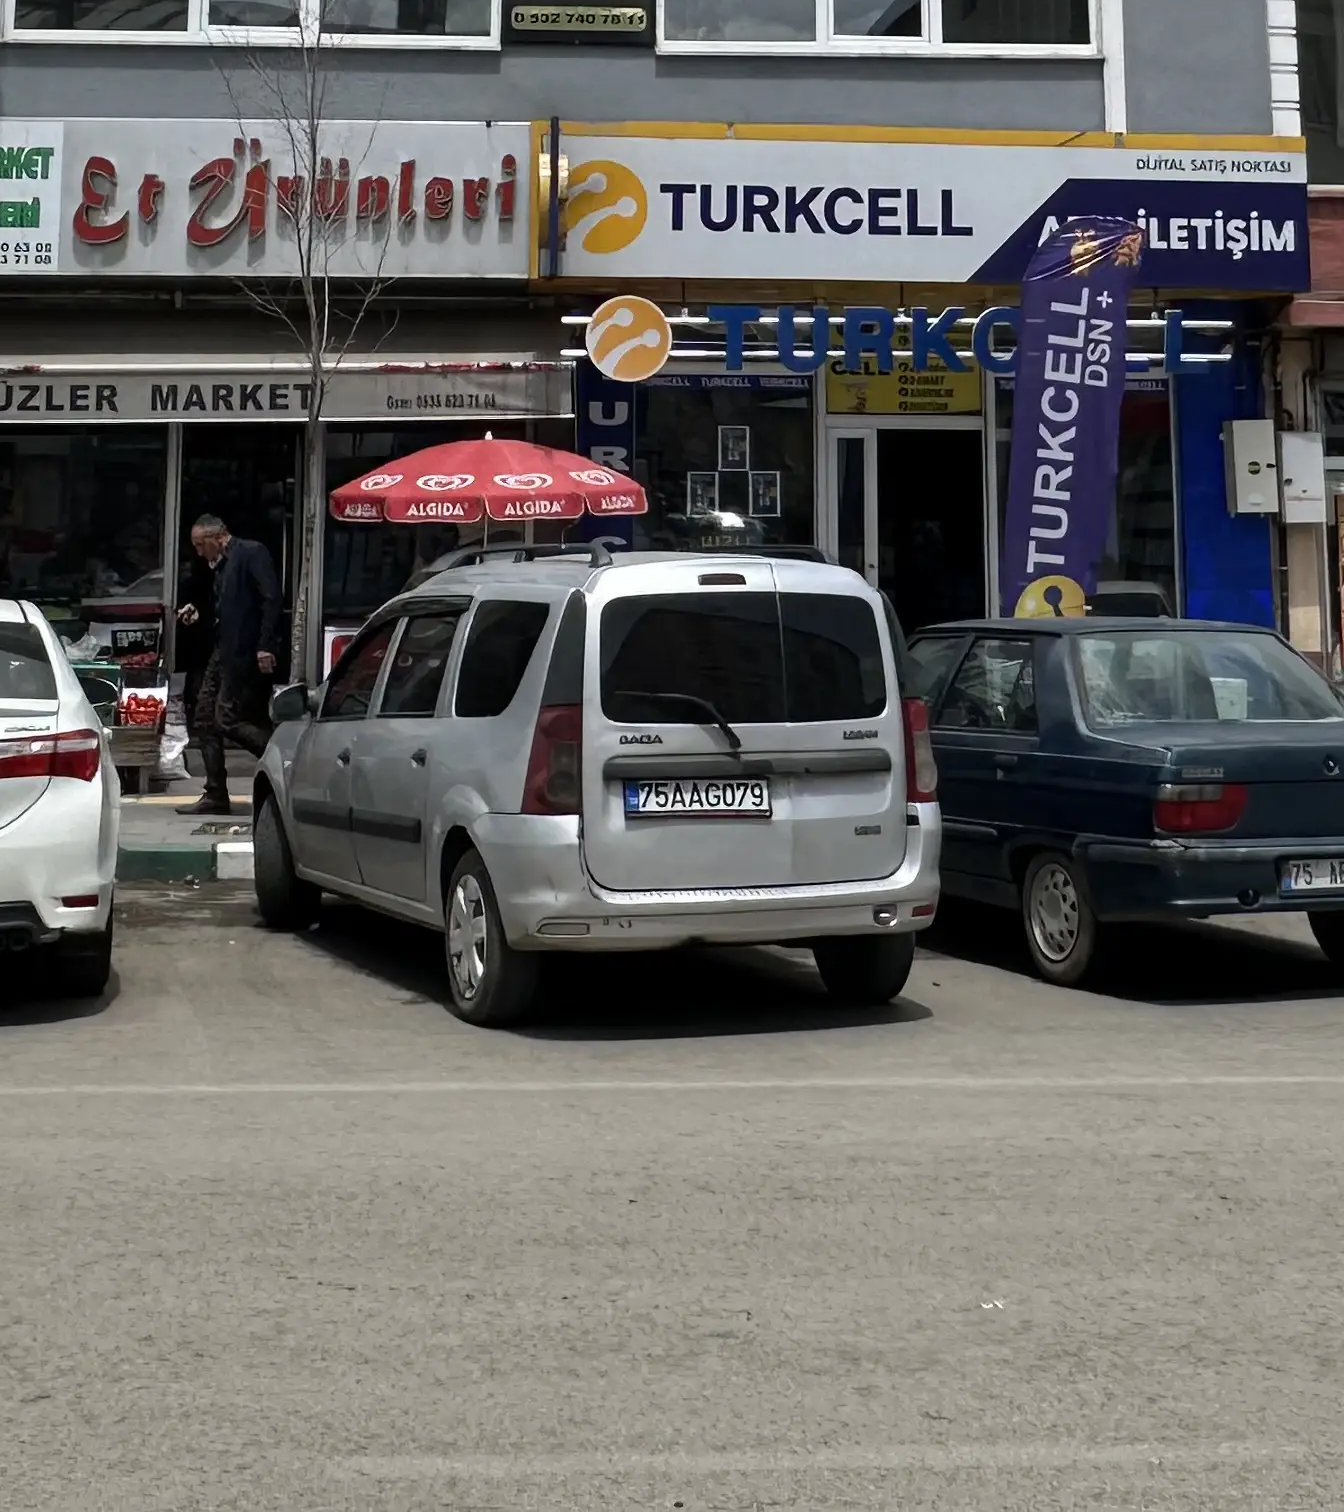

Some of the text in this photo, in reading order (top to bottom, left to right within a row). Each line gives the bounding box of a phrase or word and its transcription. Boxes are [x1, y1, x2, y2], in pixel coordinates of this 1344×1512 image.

[1190, 159, 1228, 175] SATIŞ
[1231, 160, 1291, 174] NOKTASI
[186, 137, 517, 247] Ürünleri
[659, 183, 974, 237] TURKCELL
[1136, 207, 1297, 261] İLETİŞİM
[1085, 318, 1113, 388] DSN
[151, 383, 315, 412] MARKET
[1026, 287, 1089, 573] TURKCELL
[406, 501, 465, 517] ALGIDA
[504, 500, 563, 516] ALGIDA
[1292, 862, 1313, 886] 75
